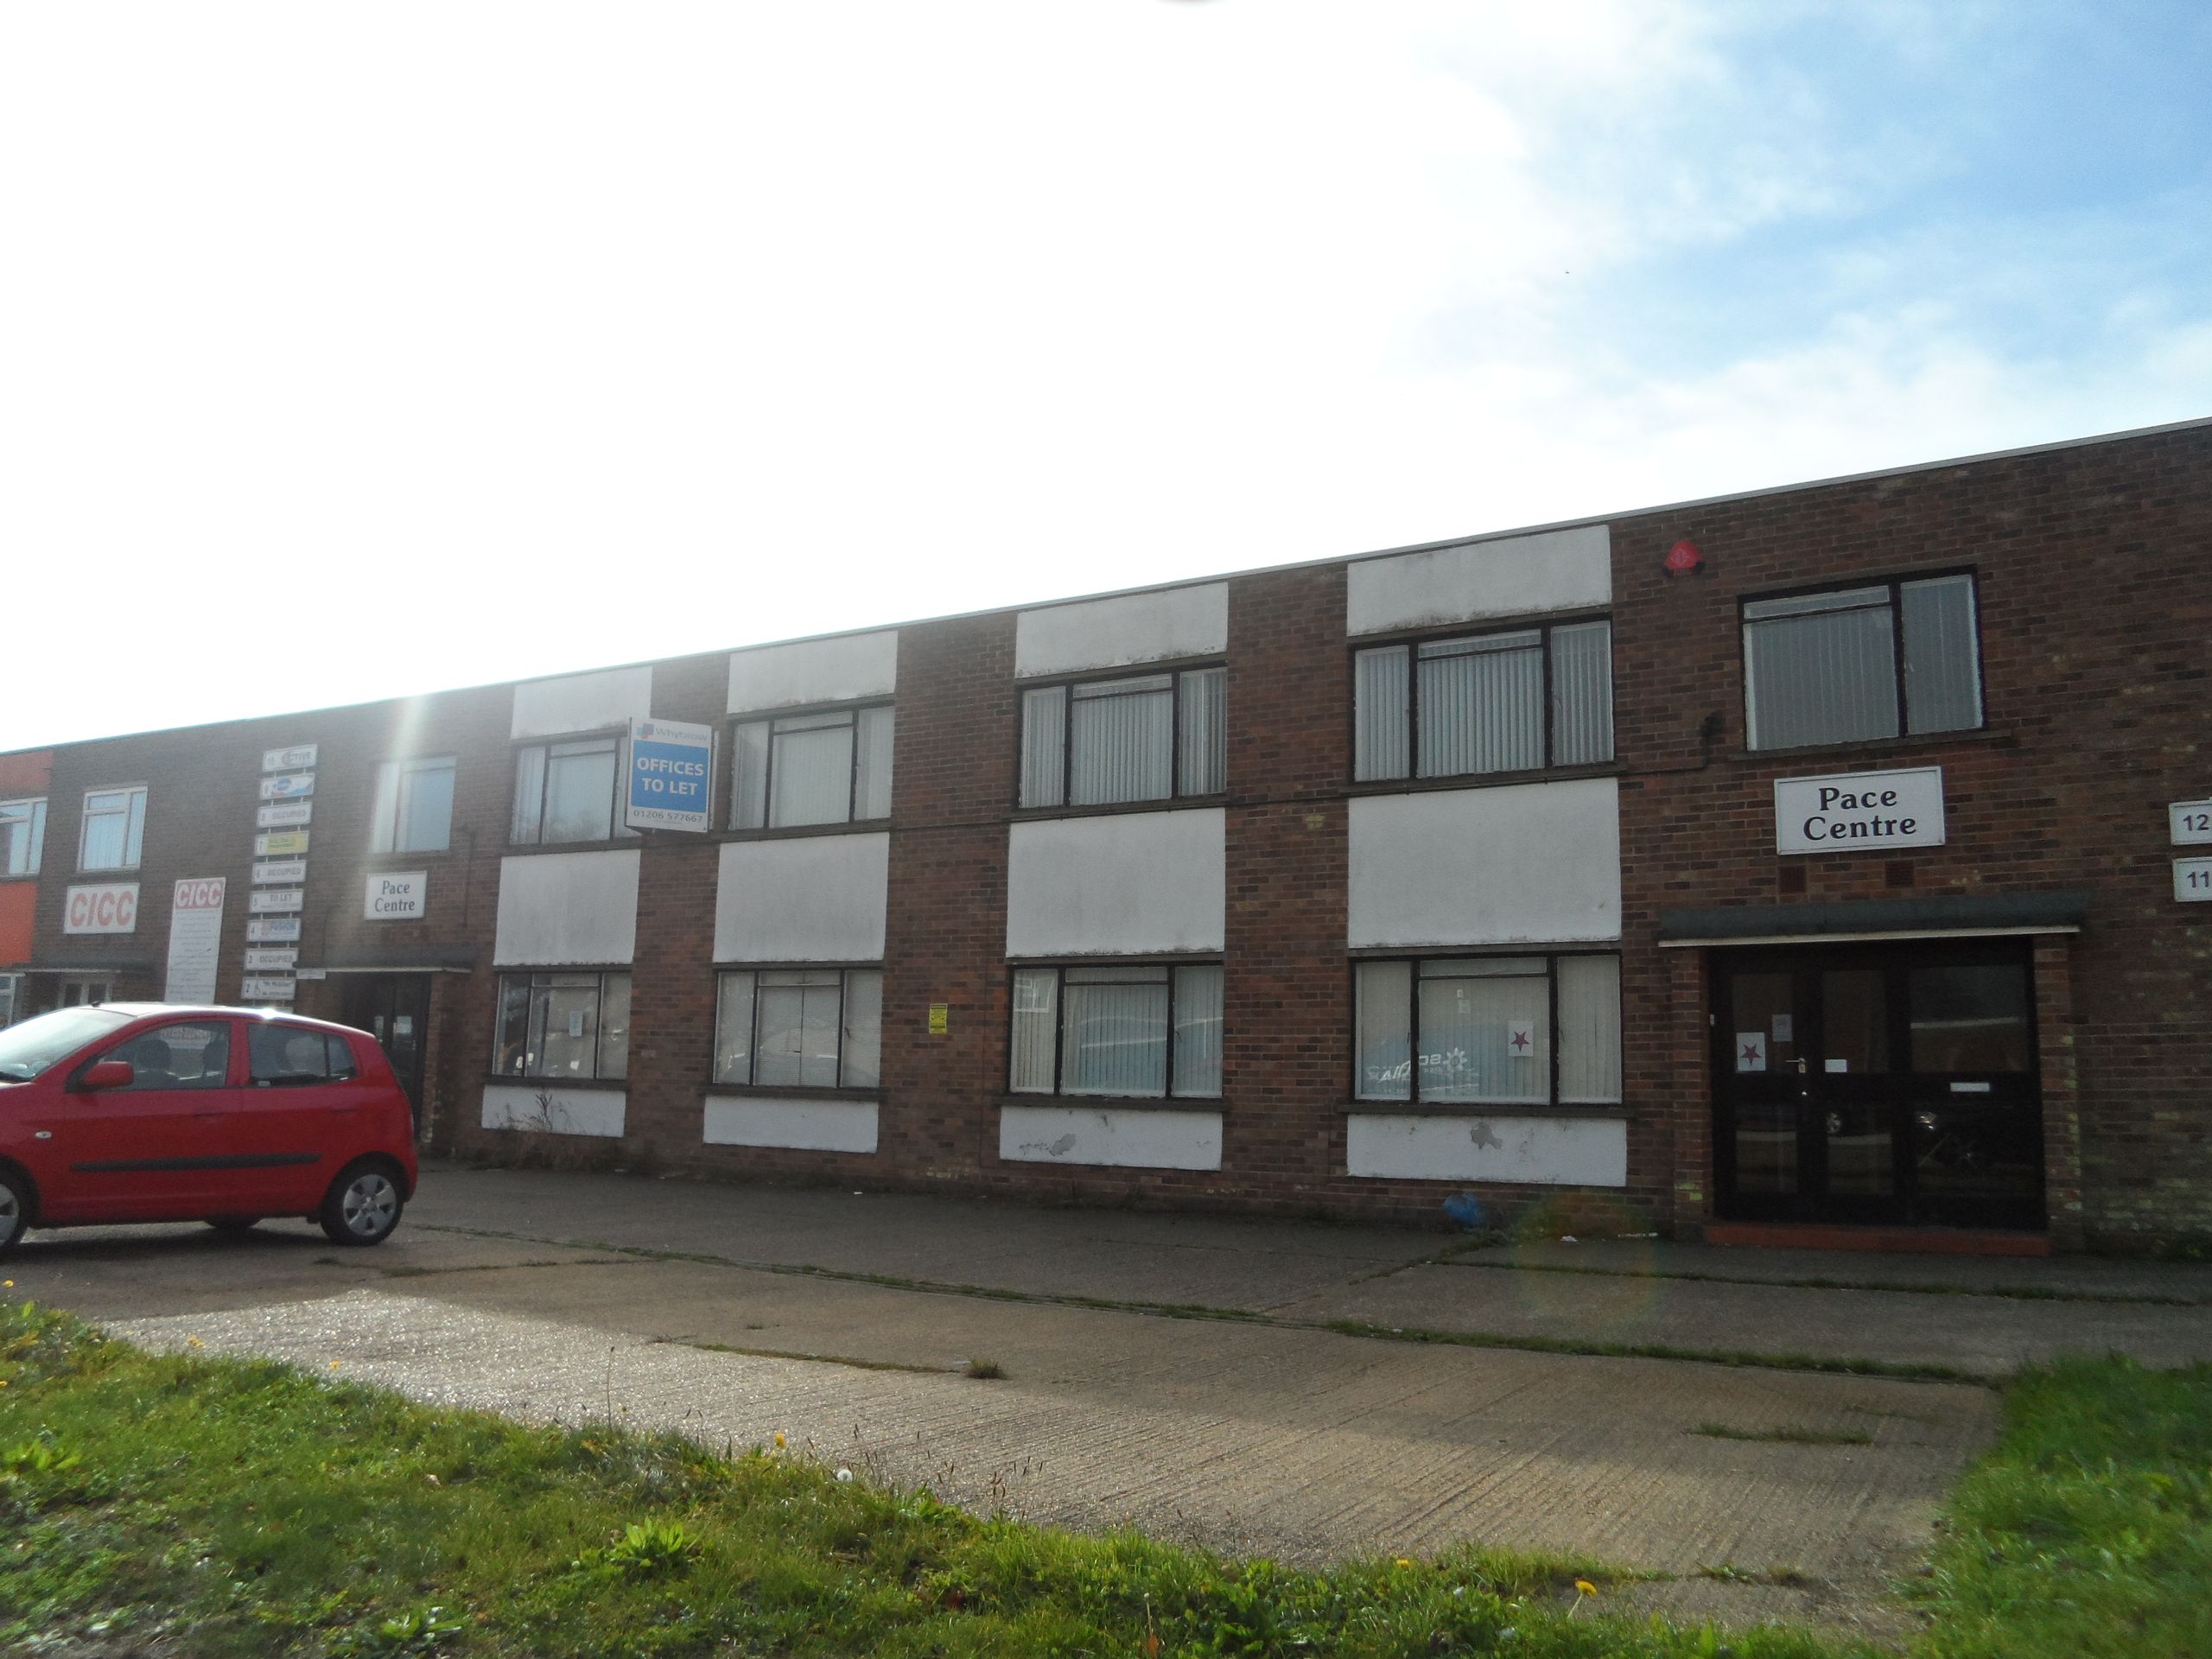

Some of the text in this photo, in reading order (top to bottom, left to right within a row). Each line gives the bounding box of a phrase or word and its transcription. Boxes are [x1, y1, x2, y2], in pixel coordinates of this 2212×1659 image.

[637, 757, 704, 776] OFFICES
[642, 778, 698, 796] TO LET
[1819, 787, 1897, 811] Pace
[633, 809, 664, 819] 01206
[667, 812, 703, 823] 577667
[2183, 814, 2209, 831] 12
[1803, 815, 1916, 841] Centre
[267, 867, 302, 876] OCCUPIED
[2187, 871, 2210, 888] 11
[177, 882, 222, 907] CICC
[382, 880, 410, 894] Pace
[70, 890, 134, 927] CICC
[374, 897, 416, 912] Centre
[260, 954, 294, 963] OCCUPIED
